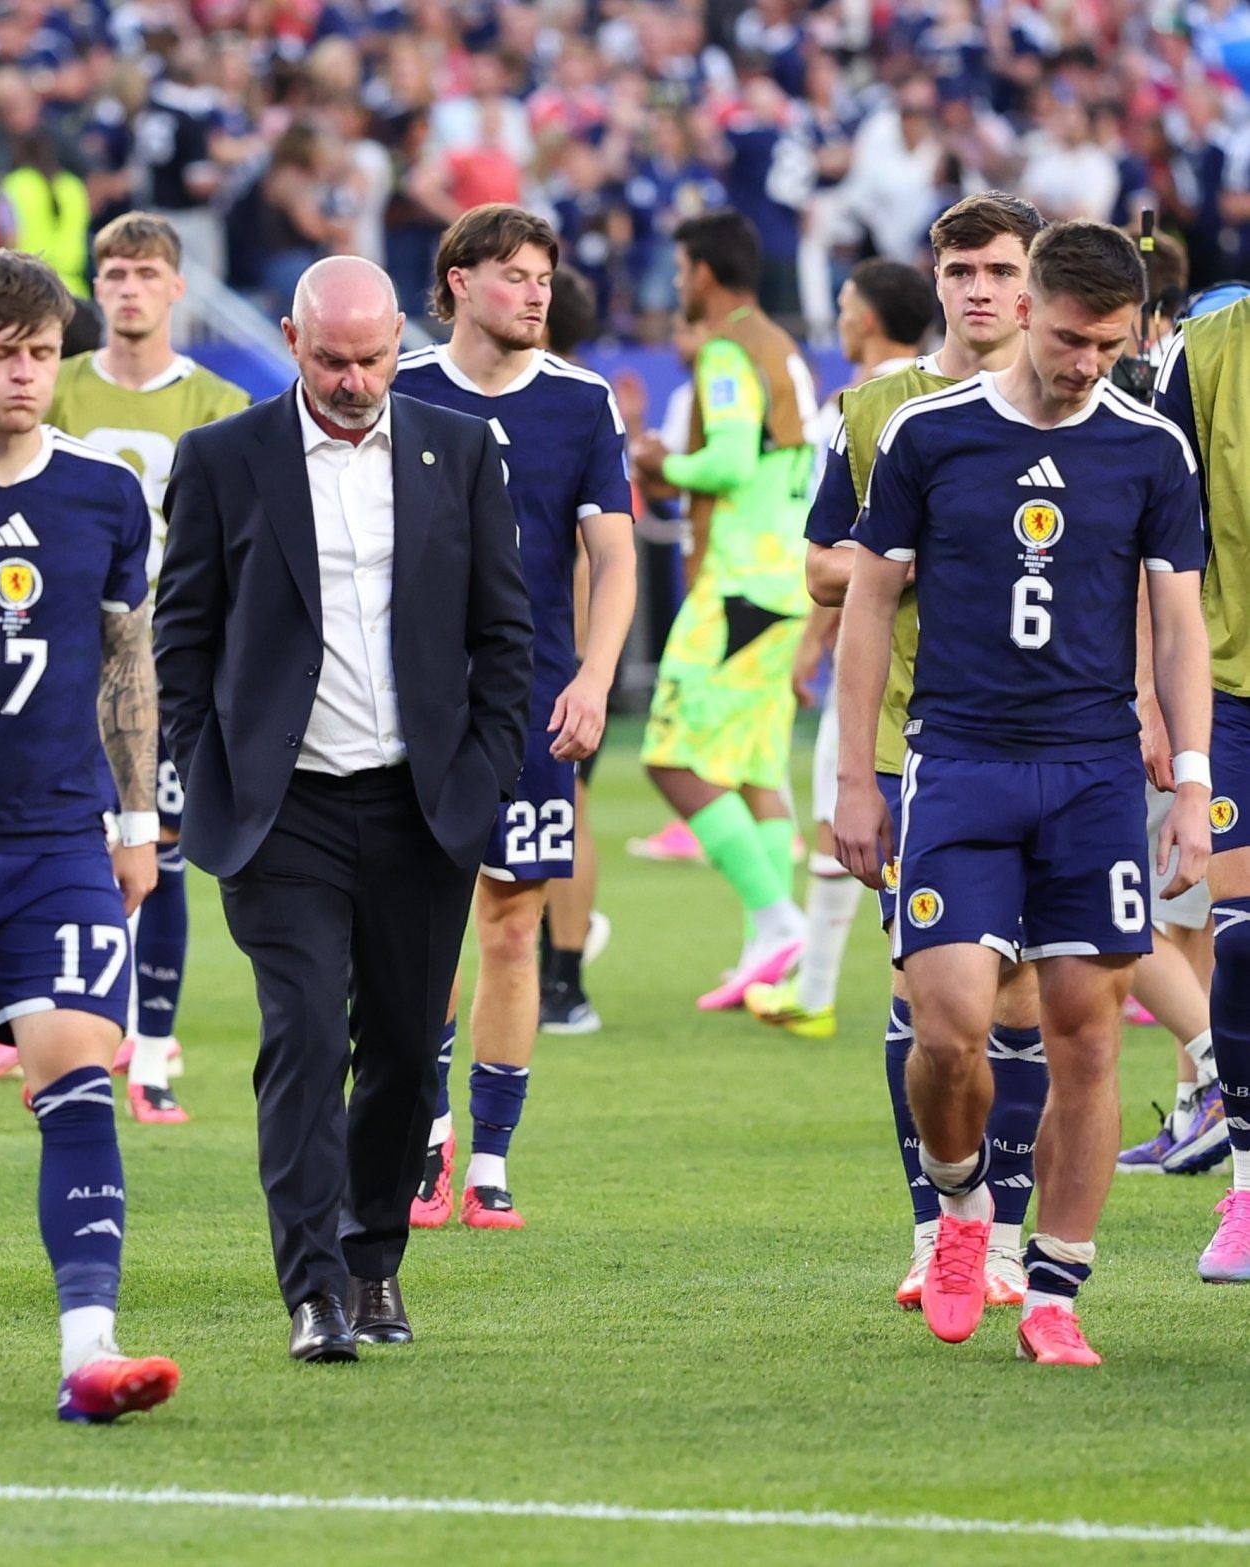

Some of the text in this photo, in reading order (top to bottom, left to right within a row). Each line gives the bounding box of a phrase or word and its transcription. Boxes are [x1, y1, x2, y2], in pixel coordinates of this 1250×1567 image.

[1010, 575, 1054, 649] 6
[505, 798, 574, 865] 22
[1109, 860, 1146, 934] 6
[53, 923, 127, 998] 17
[1219, 1081, 1250, 1098] ALB
[67, 1184, 125, 1202] ALBA
